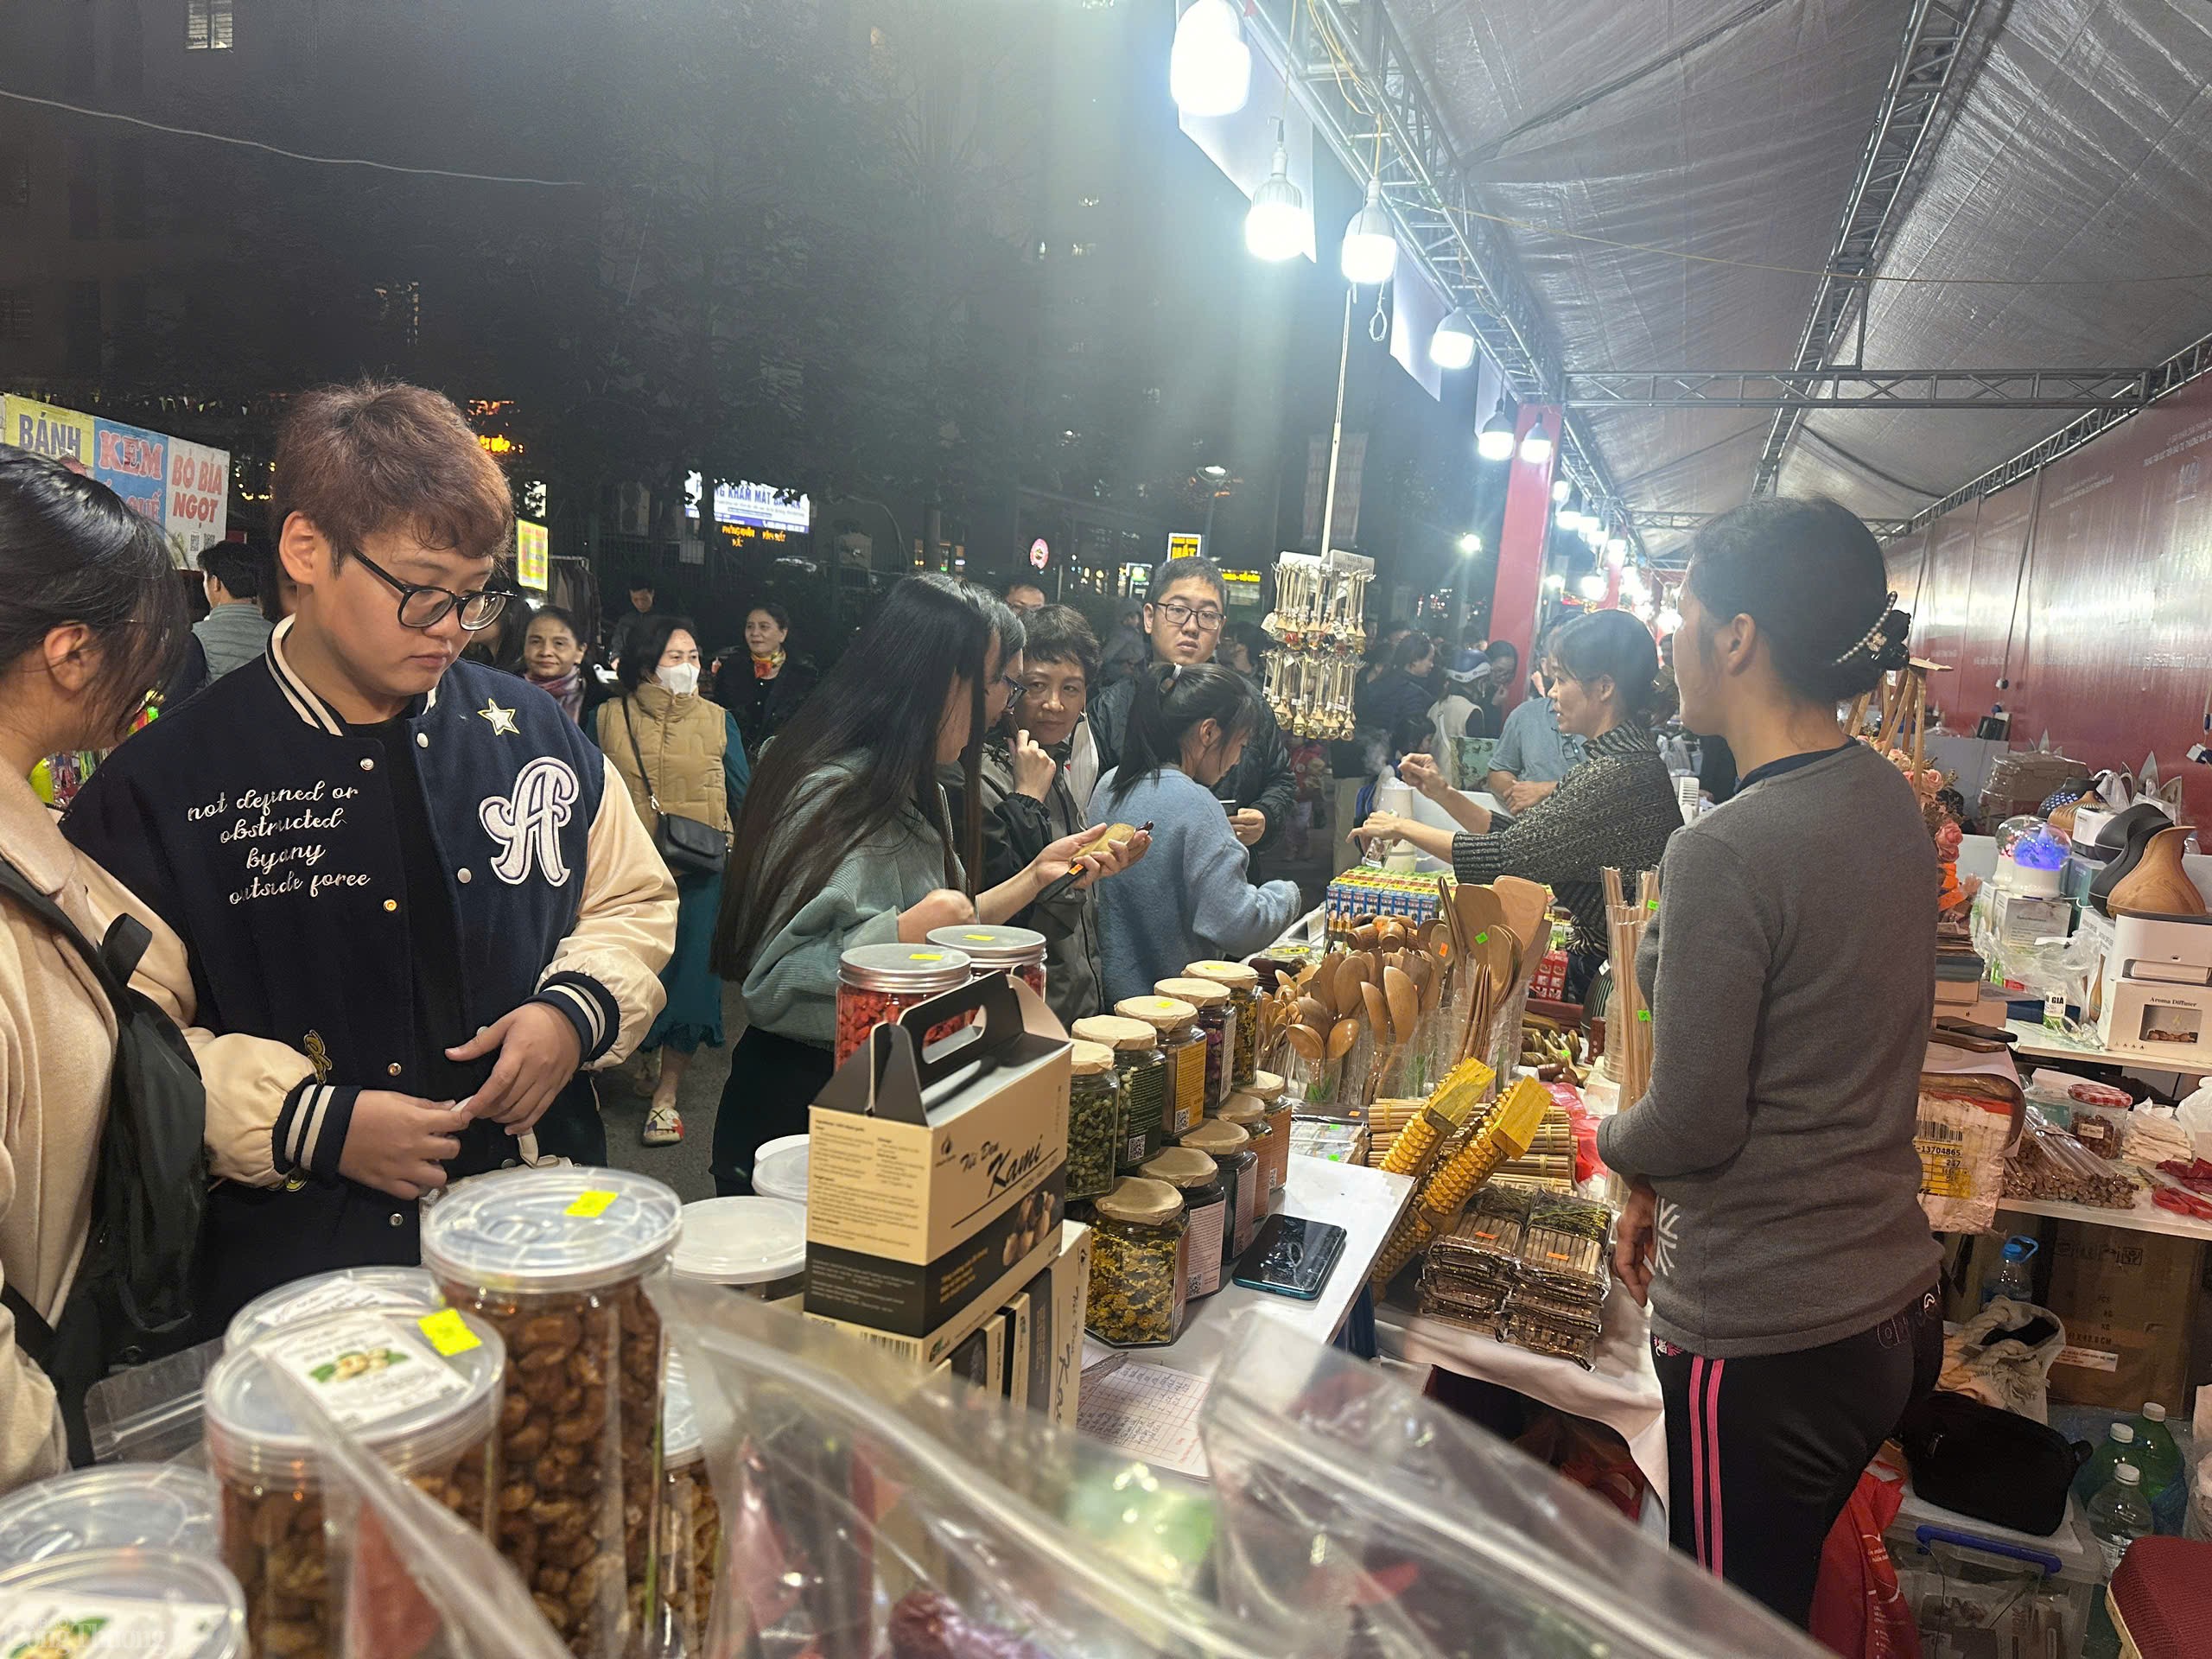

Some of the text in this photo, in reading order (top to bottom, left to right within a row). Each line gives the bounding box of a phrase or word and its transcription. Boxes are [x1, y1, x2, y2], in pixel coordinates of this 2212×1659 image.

[19, 412, 81, 461] BÁNH
[99, 430, 163, 480] KEM
[172, 492, 219, 529] NGỌT
[188, 780, 359, 821] not defined or
[220, 807, 346, 843] obstructed
[229, 871, 371, 905] outside force
[2149, 996, 2197, 1007] Aroma Diffuser
[987, 1134, 1044, 1198] Kami
